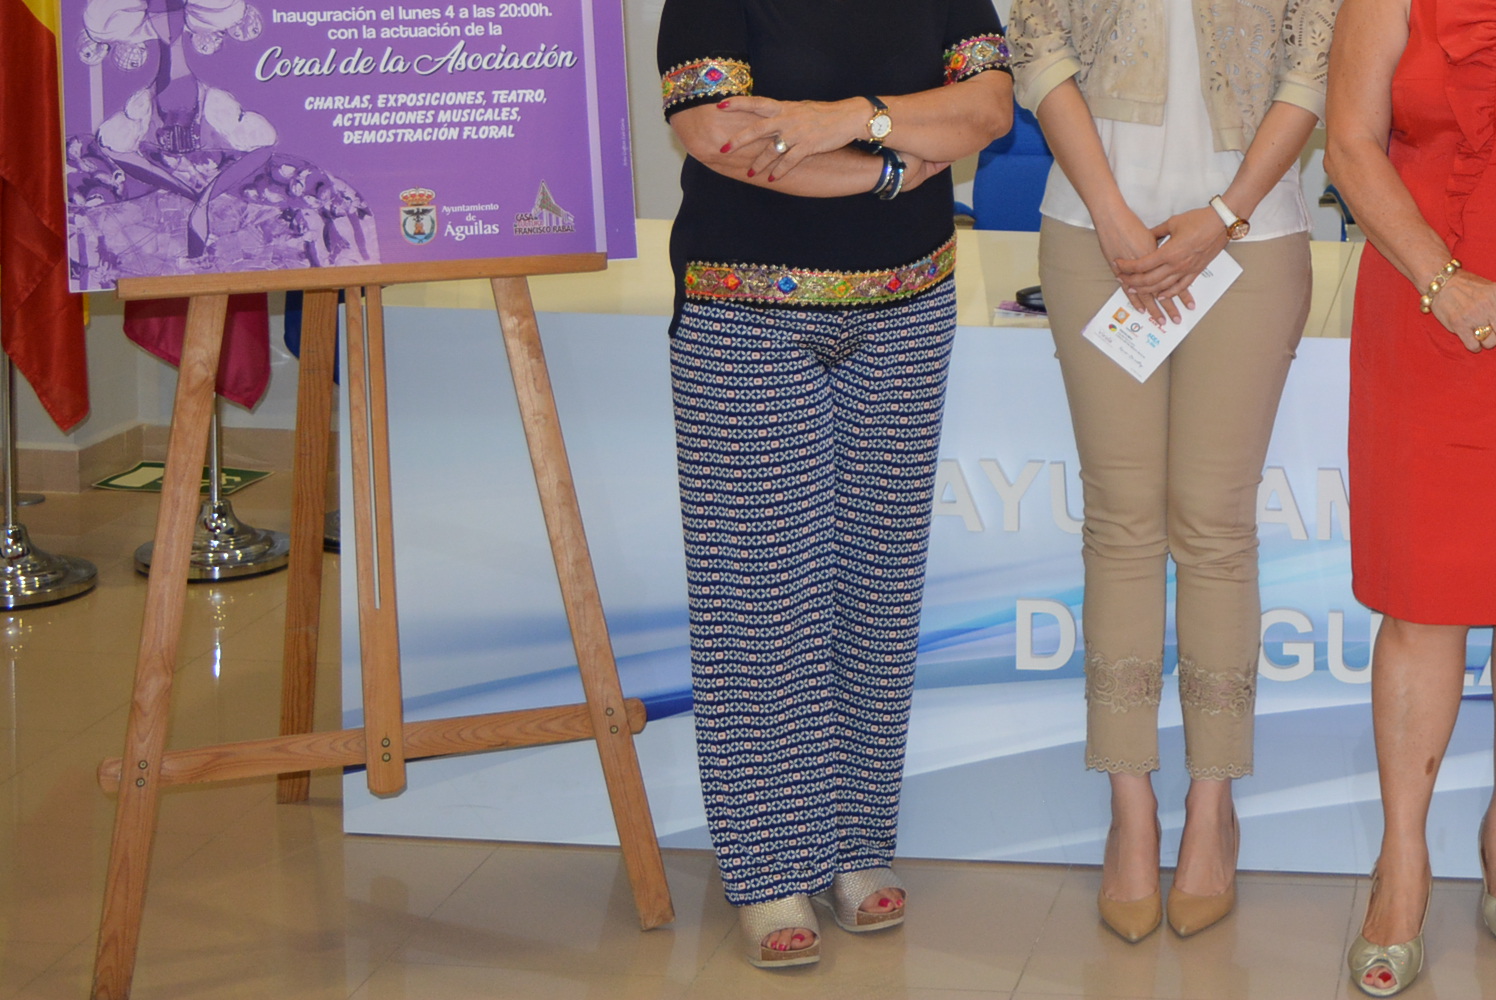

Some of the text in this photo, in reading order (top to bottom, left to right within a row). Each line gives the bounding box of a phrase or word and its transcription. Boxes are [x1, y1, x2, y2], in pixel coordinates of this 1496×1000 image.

[272, 2, 552, 26] Inauguración el lunes 4 a las 20:00h.
[327, 22, 502, 40] con la actuación de la
[255, 40, 577, 81] Coral de la Asociación
[304, 89, 547, 110] CHARLAS, EXPOSICIONES, TEATRO,
[332, 107, 521, 127] ACTUACIONES MUSICALES,
[343, 123, 515, 144] DEMOSTRACIÓN FLORAL
[441, 203, 499, 216] Ayuntamiento
[465, 213, 476, 222] de
[444, 221, 499, 241] Águilas
[514, 226, 551, 235] FRANCISCO
[1016, 599, 1077, 670] D
